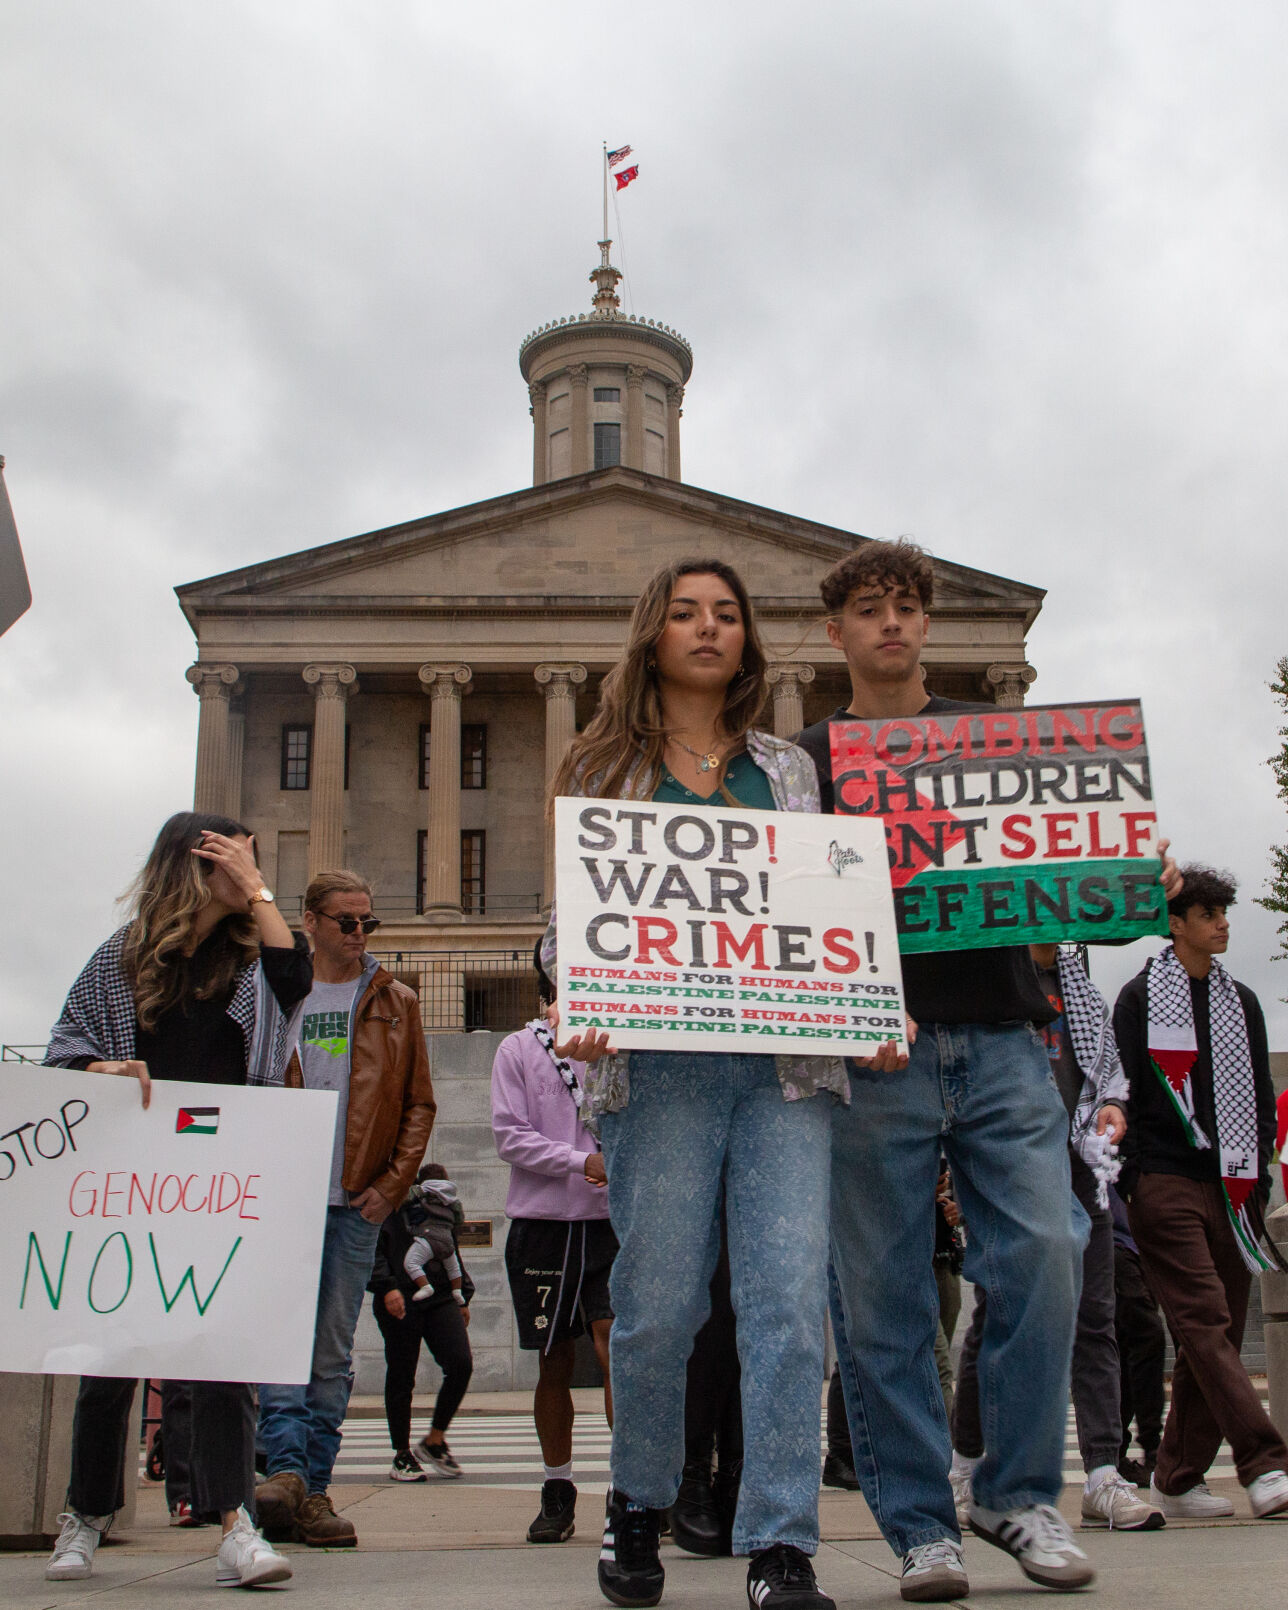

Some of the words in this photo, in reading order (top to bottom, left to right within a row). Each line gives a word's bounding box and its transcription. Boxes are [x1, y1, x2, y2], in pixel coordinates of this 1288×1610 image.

[829, 705, 1145, 766] BOMBING
[834, 755, 1154, 815] CHILDREN
[577, 806, 778, 864] STOP!
[1000, 810, 1158, 860] SELF
[579, 856, 771, 917] WAR!
[893, 874, 1160, 935] EFENSE
[585, 912, 879, 975] CRIMES!
[567, 966, 678, 983] HUMANS
[682, 972, 734, 986] FOR
[738, 976, 845, 993] HUMANS
[848, 983, 898, 996] FOR
[567, 981, 735, 1000] PALESTINE
[738, 990, 900, 1011] PALESTINE
[567, 1000, 679, 1017] HUMANS
[682, 1005, 735, 1019] FOR
[740, 1008, 847, 1025] HUMANS
[850, 1015, 902, 1029] FOR
[567, 1015, 737, 1034] PALESTINE
[740, 1023, 904, 1044] PALESTINE
[68, 1170, 262, 1221] GENOCIDE
[19, 1230, 243, 1317] NOW
[537, 1285, 552, 1308] 7
